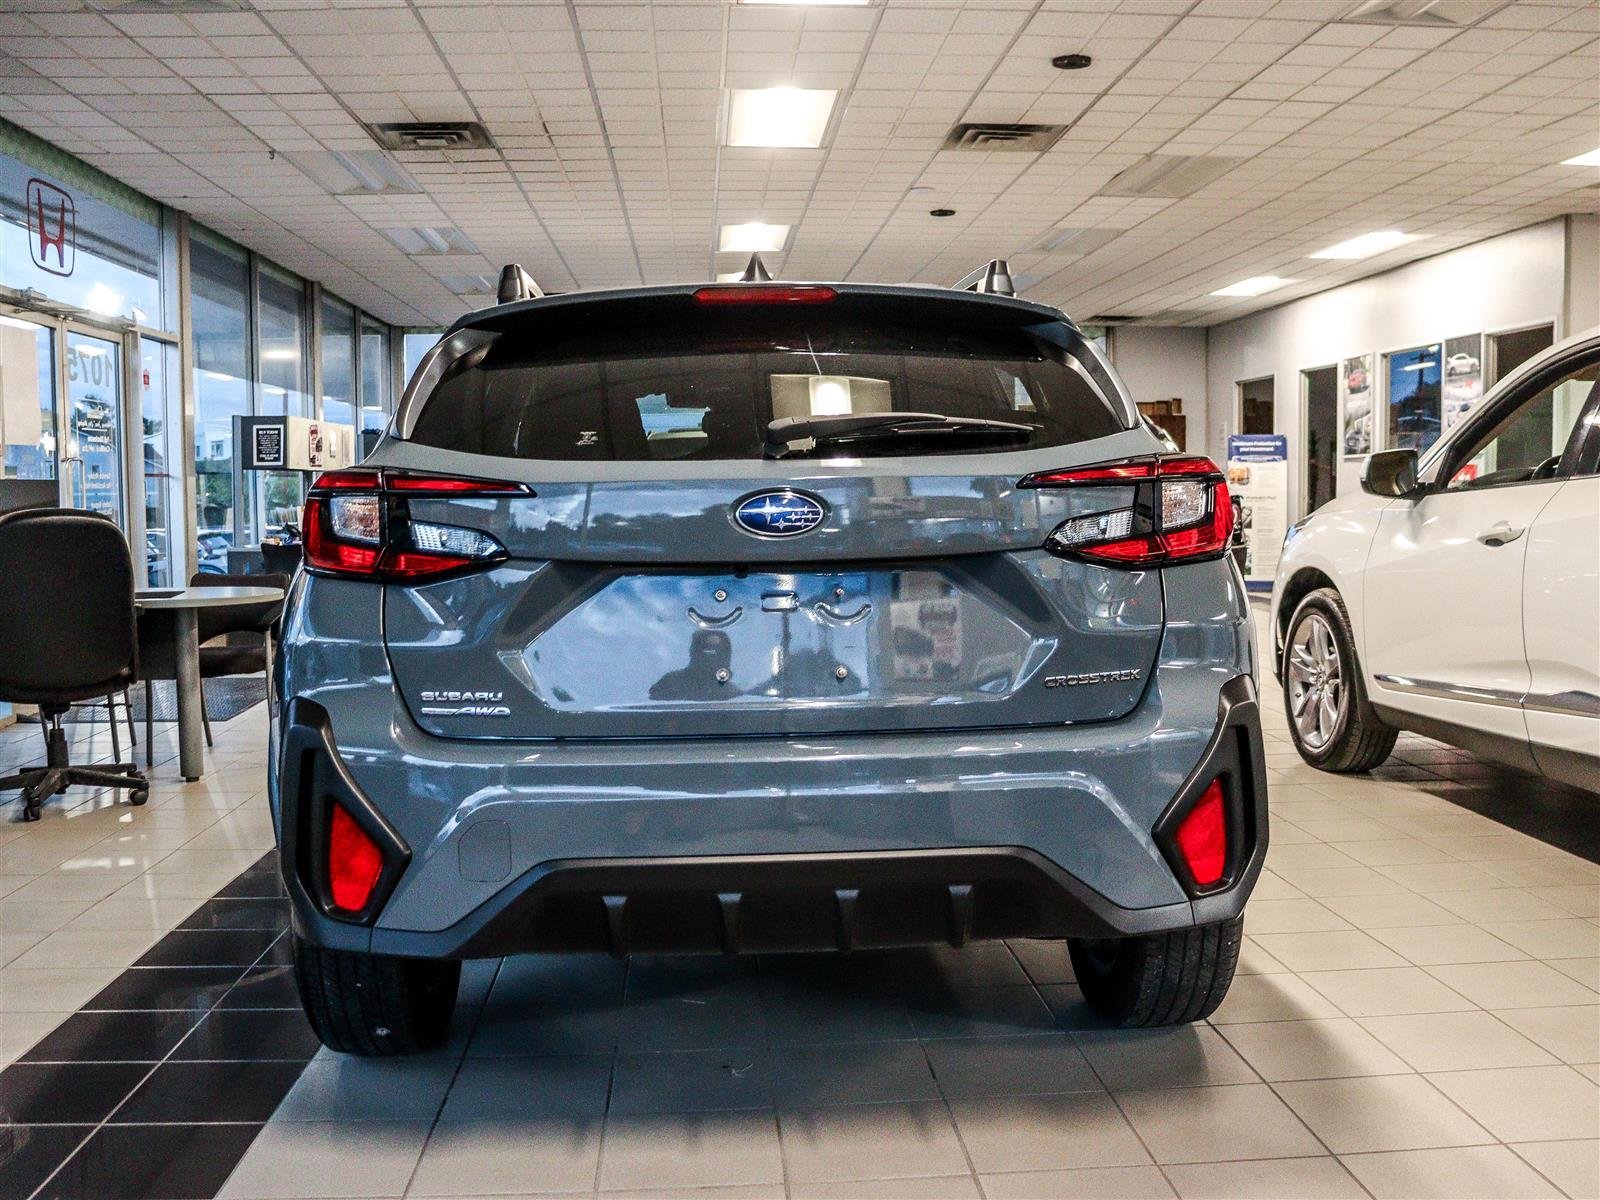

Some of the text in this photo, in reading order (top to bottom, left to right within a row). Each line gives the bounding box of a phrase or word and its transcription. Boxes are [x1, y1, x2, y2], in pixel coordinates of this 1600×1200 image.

[1045, 668, 1140, 687] CROSSTREK
[421, 691, 503, 701] SUBARU
[455, 706, 511, 715] AWD
